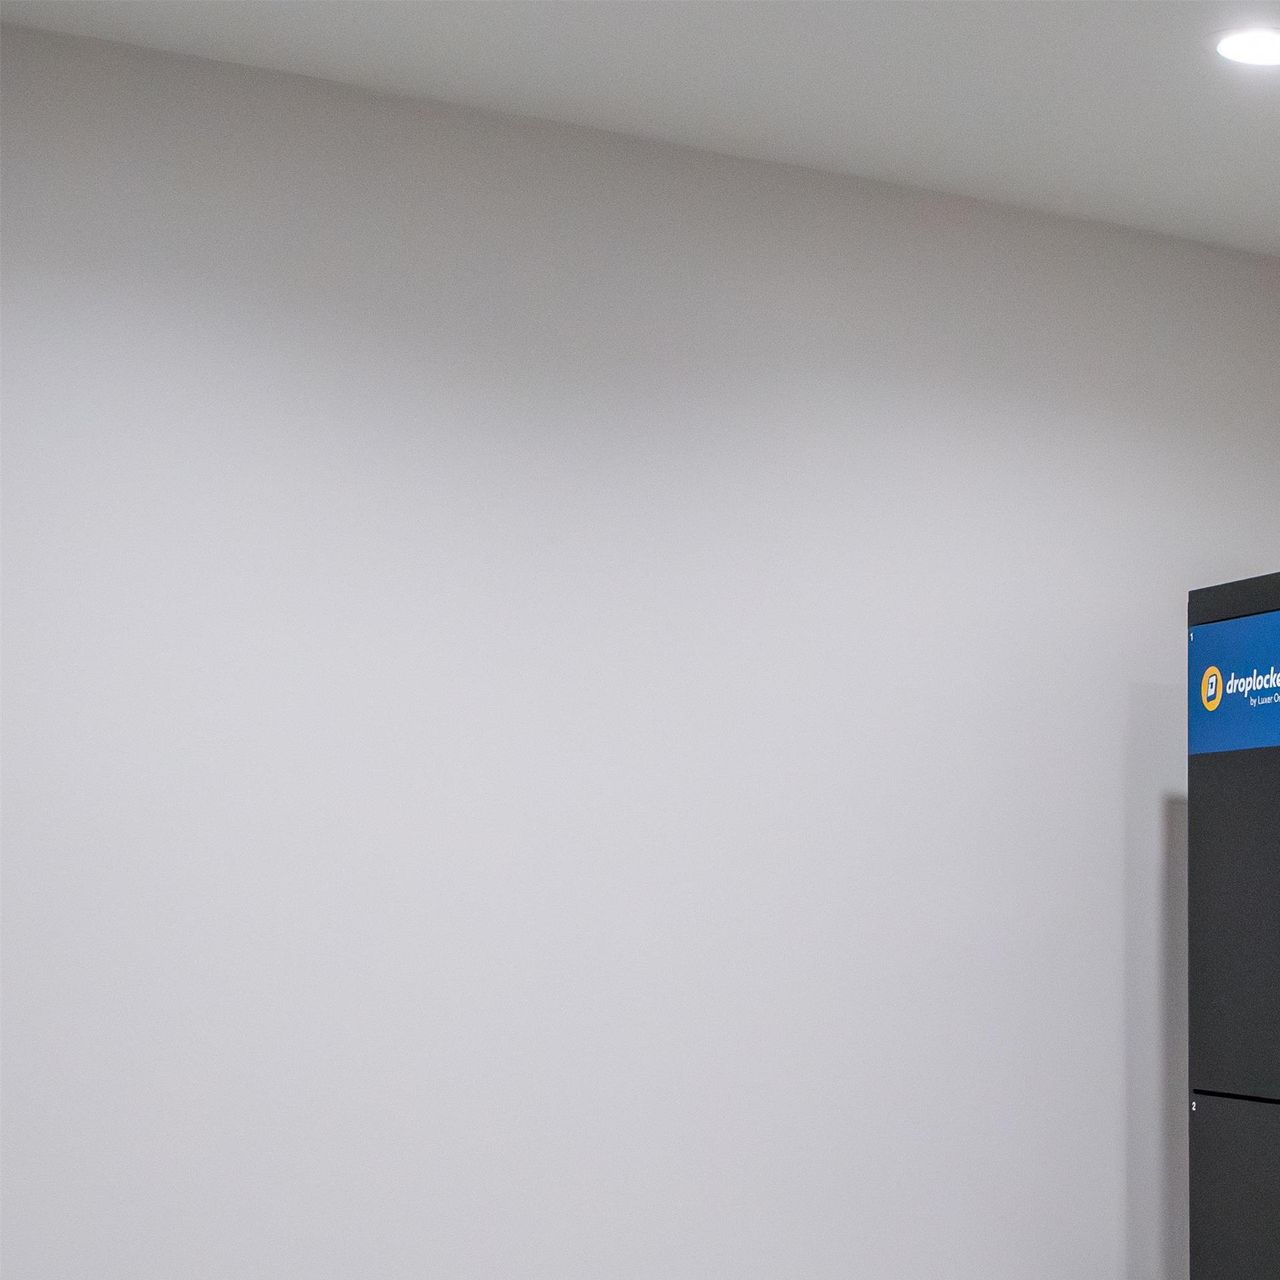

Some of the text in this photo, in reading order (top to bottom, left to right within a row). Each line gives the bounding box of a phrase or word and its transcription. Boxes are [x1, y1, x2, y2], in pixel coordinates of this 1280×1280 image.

[1190, 632, 1194, 642] 1
[1250, 696, 1257, 707] by
[1258, 694, 1273, 705] Luxer
[1191, 1101, 1197, 1111] 2
